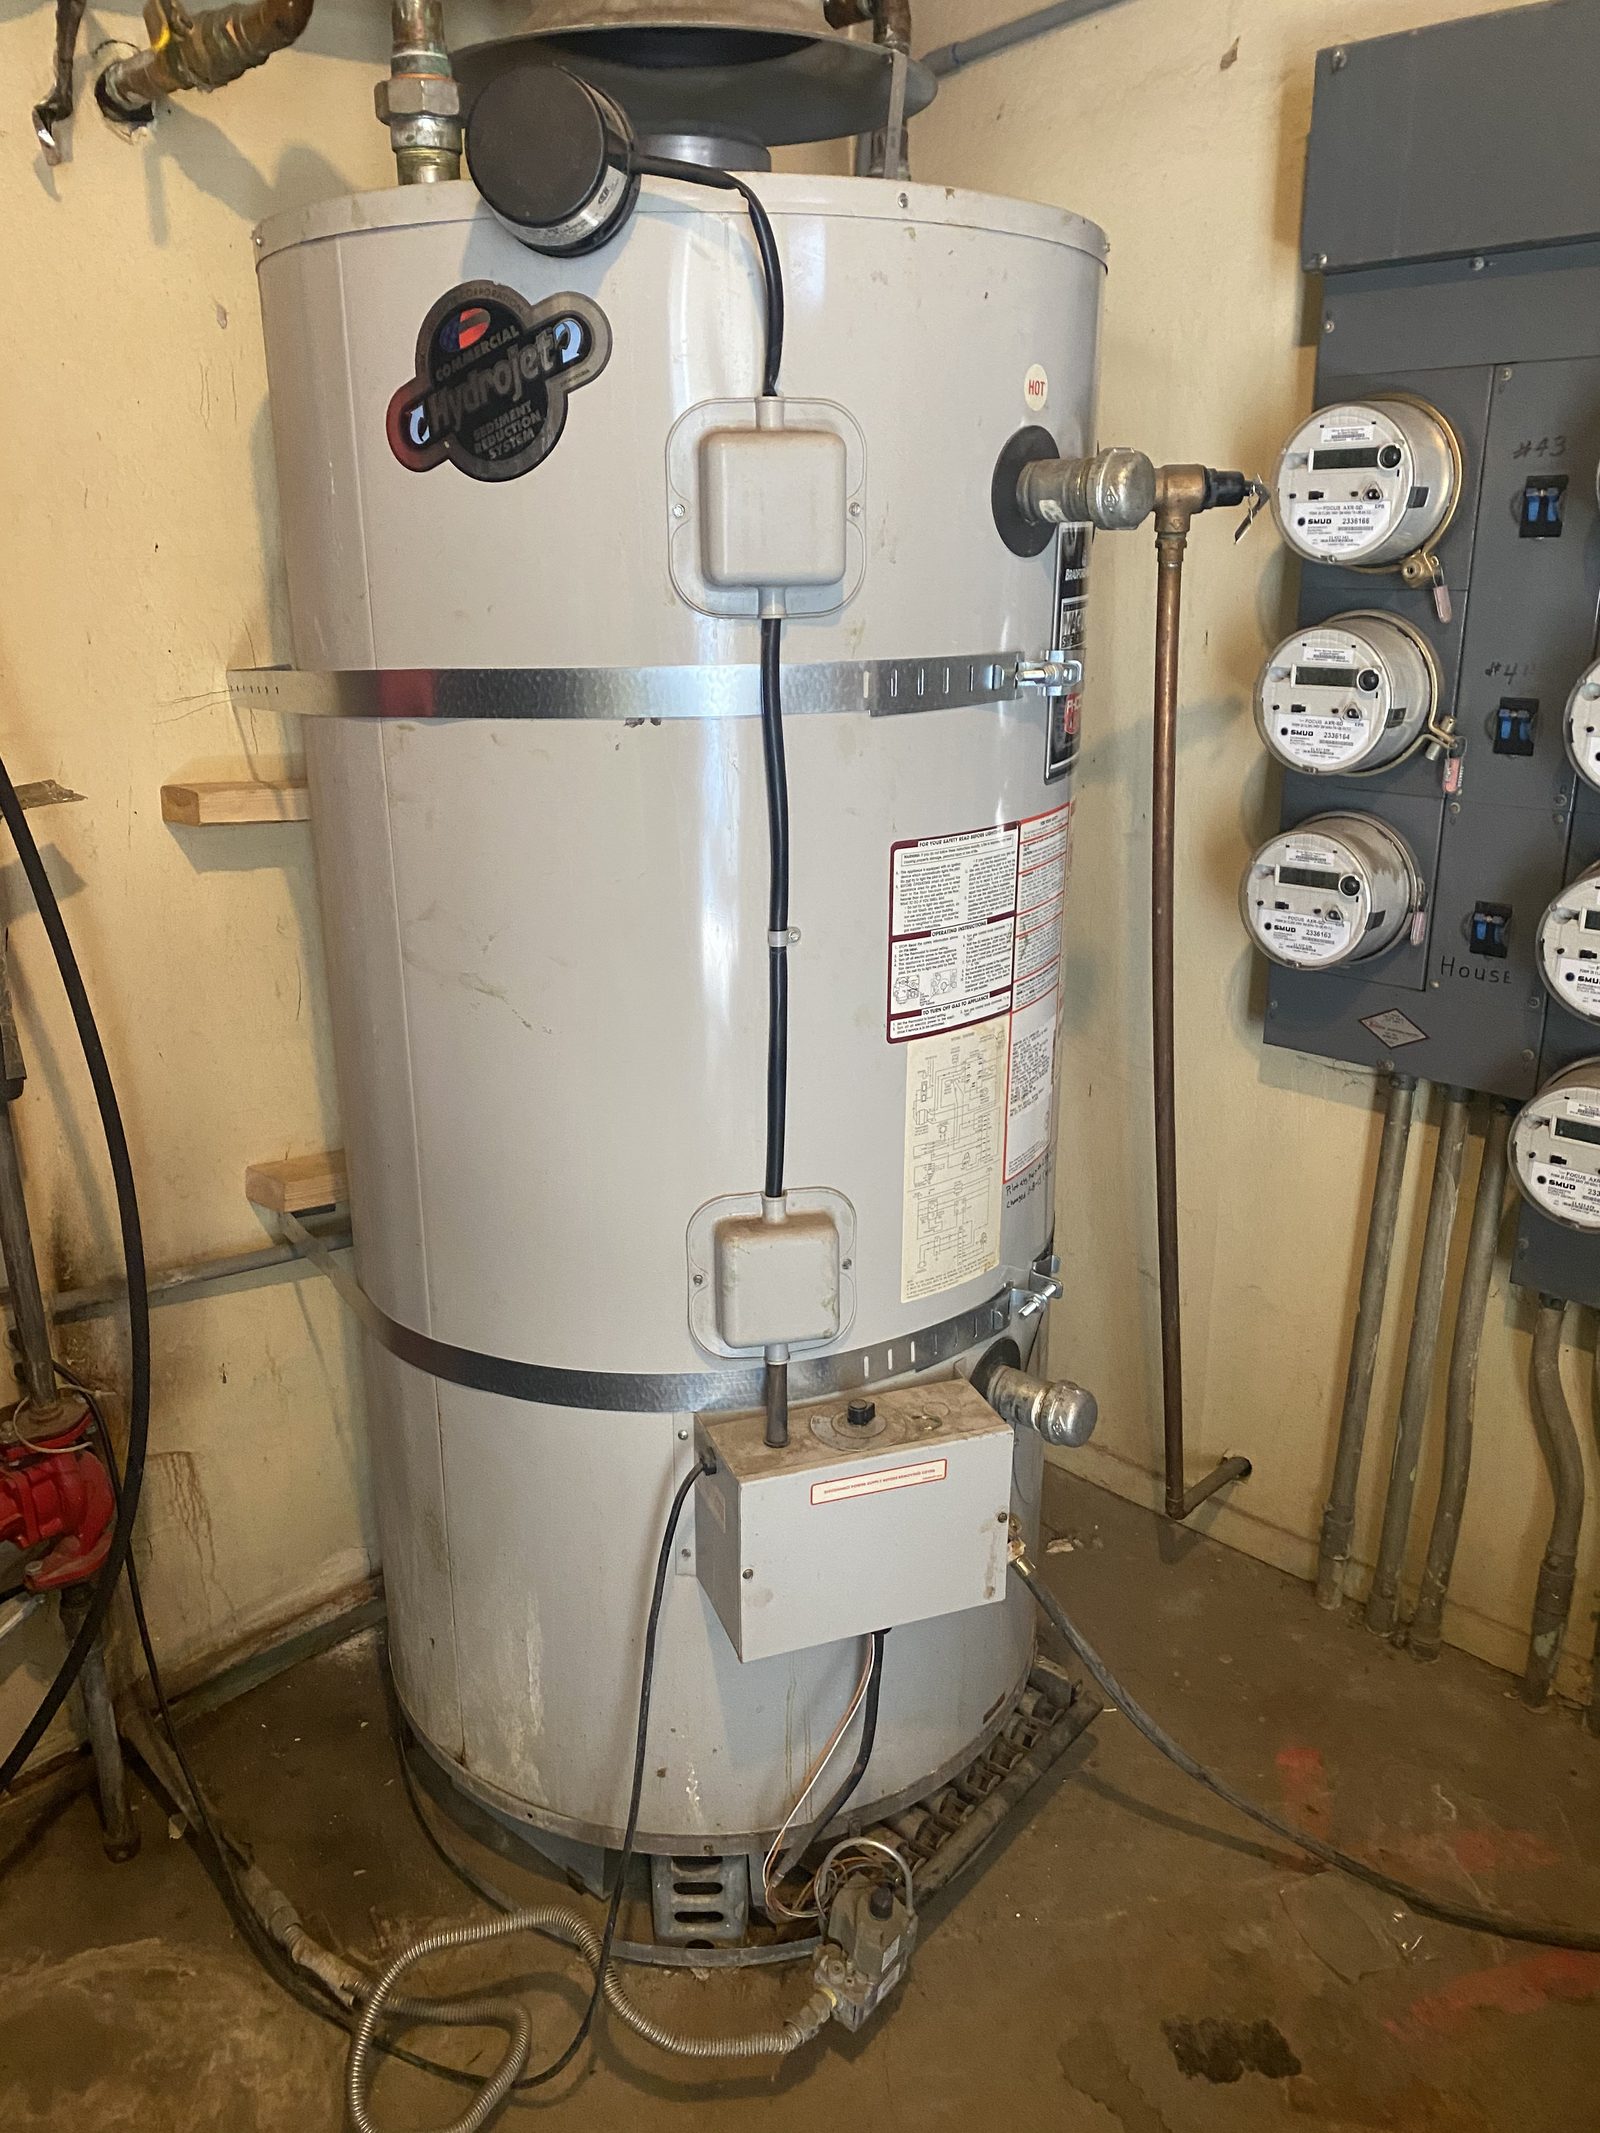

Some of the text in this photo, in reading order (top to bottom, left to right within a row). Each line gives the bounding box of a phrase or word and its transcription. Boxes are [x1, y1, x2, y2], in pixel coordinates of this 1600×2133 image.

[435, 325, 519, 382] COMMERCIAL
[1028, 379, 1046, 397] HOT
[473, 400, 532, 440] SEDIMENT
[474, 409, 542, 454] REDUCTION
[489, 428, 535, 460] SYSTEM
[1290, 729, 1314, 737] SMUD
[931, 921, 987, 937] OPERATING INSTRUCTIONS
[1274, 924, 1296, 933] SMUD
[1577, 975, 1600, 986] SMU
[967, 995, 989, 1006] APPLIANCE
[1548, 1179, 1576, 1191] SMUD
